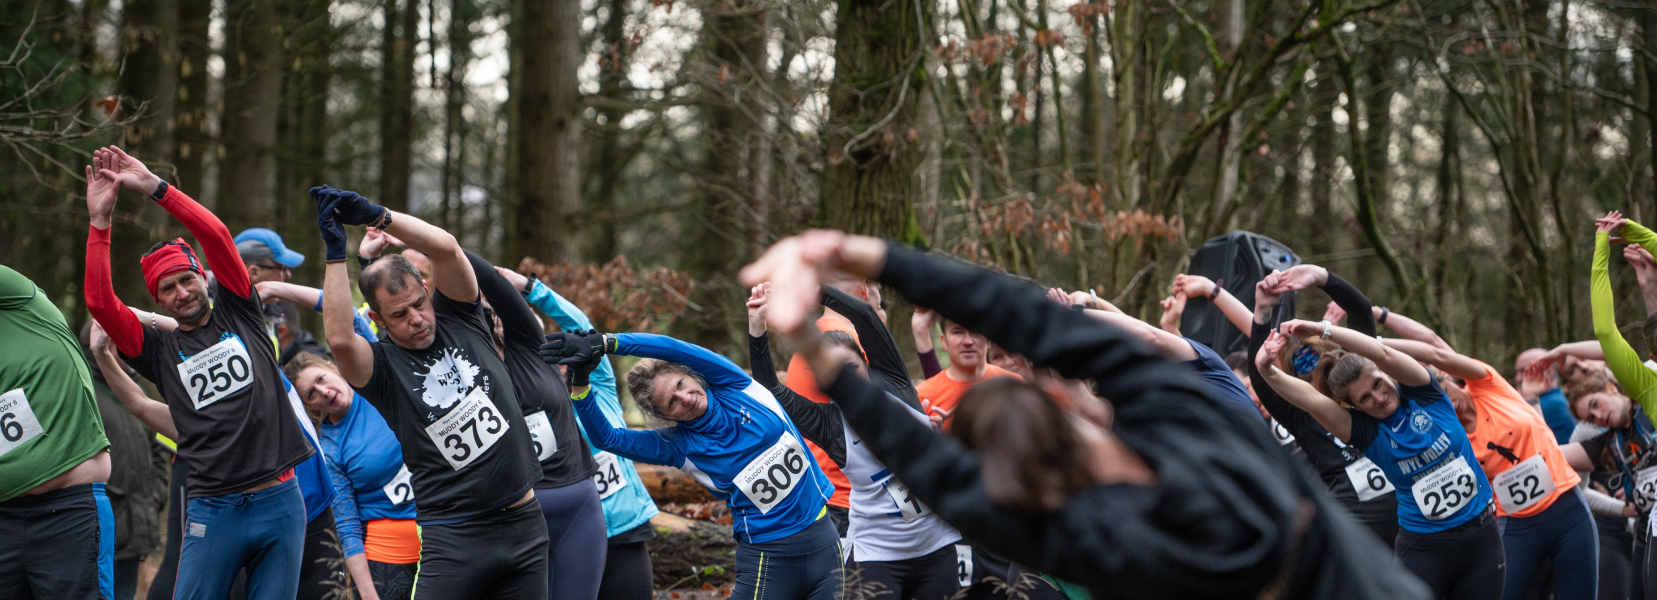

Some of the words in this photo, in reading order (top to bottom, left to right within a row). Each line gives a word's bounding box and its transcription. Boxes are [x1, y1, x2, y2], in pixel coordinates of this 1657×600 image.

[186, 360, 207, 375] MUDDY
[207, 349, 230, 365] WOODY
[190, 354, 249, 402] 250
[438, 421, 460, 438] MUDDY
[459, 404, 479, 422] WOODY
[449, 410, 461, 420] Valley
[444, 406, 502, 462] 373
[745, 465, 765, 484] MUDDY
[763, 447, 785, 466] WOODY
[751, 448, 804, 505] 306
[1397, 456, 1423, 475] WYE
[1420, 479, 1440, 494] MUDDY
[1440, 469, 1459, 483] WOODY
[1423, 473, 1474, 517] 253
[1508, 474, 1545, 506] 52
